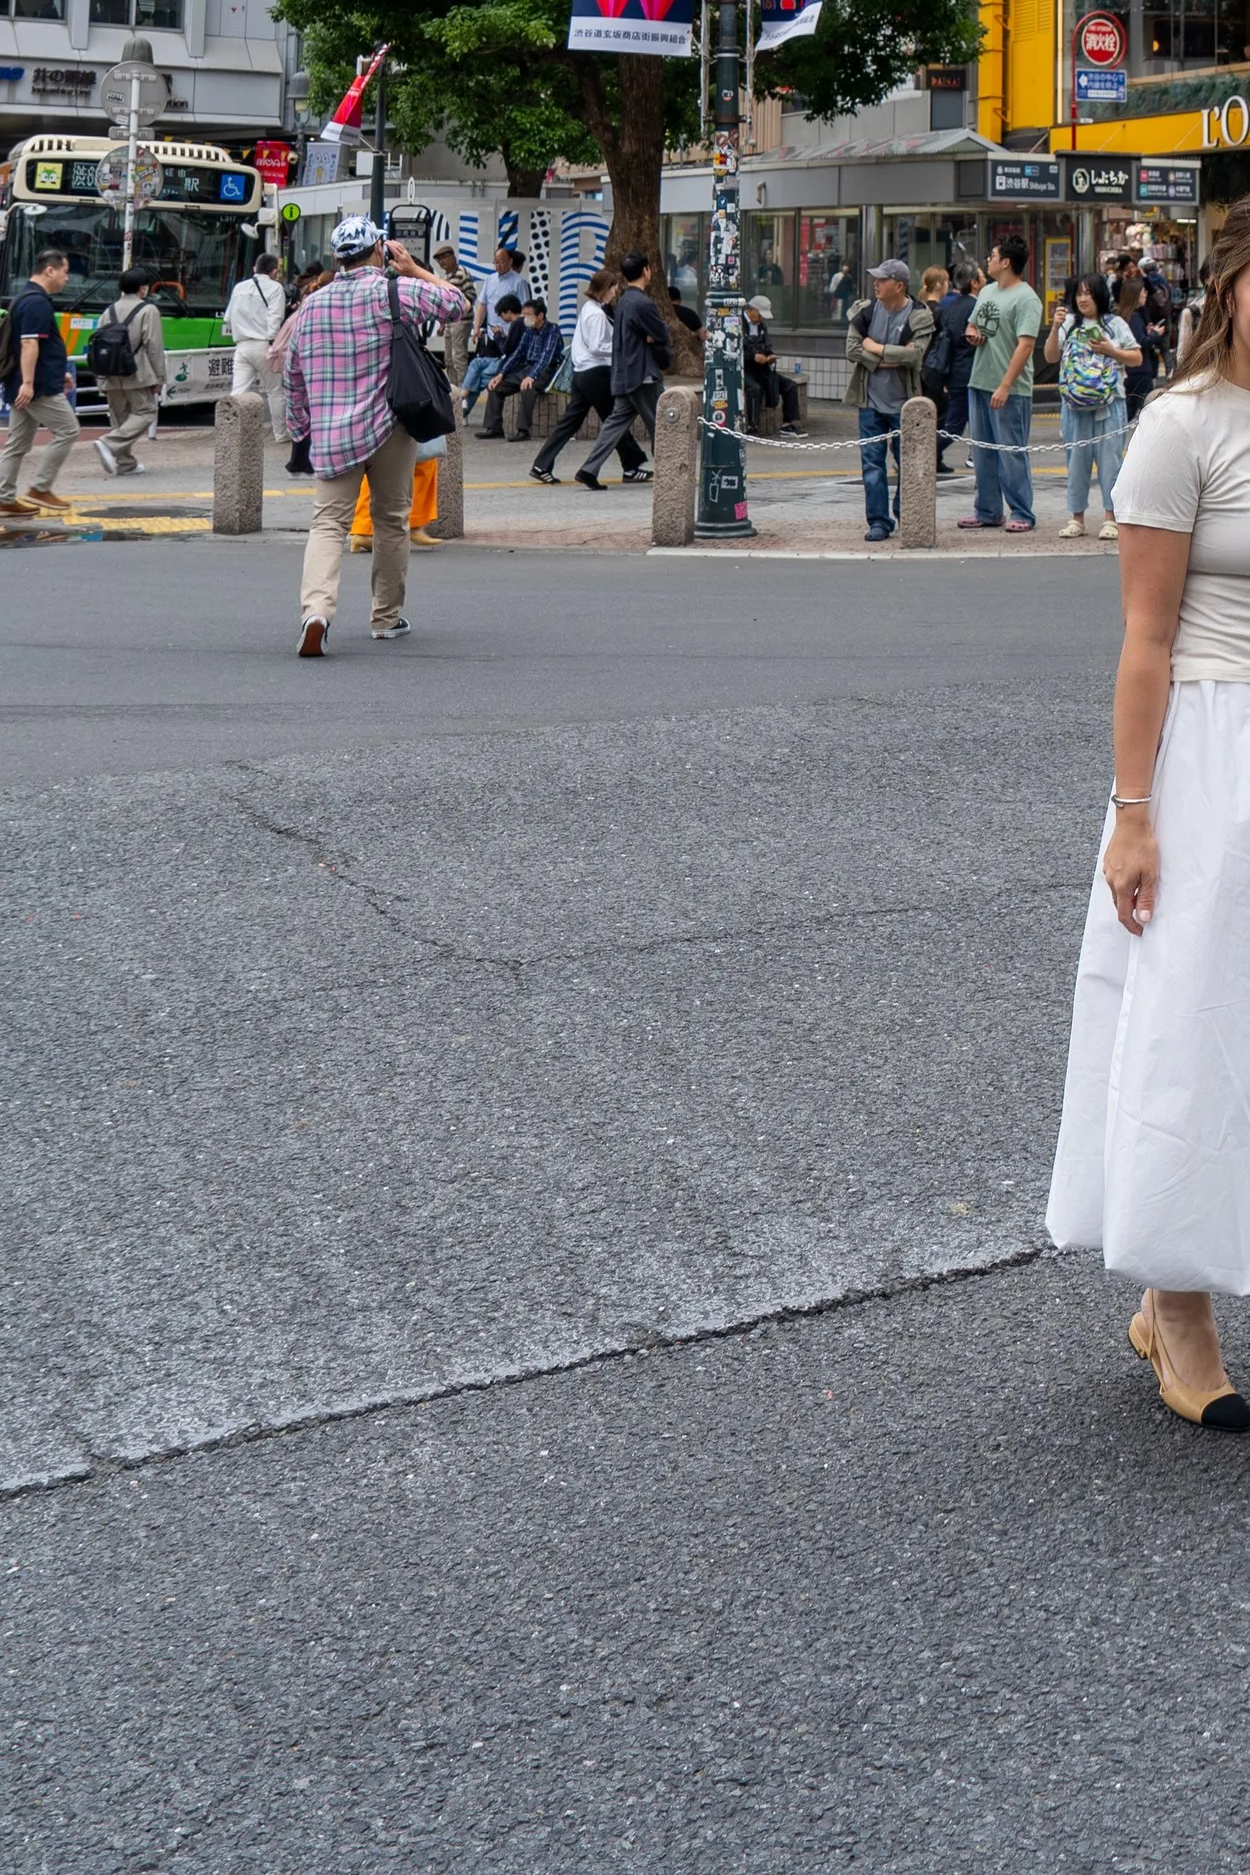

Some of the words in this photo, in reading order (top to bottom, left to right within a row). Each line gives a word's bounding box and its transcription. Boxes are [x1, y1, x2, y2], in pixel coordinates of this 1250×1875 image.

[574, 28, 687, 45] 渋谷道玄坂商店街振興組合
[1085, 32, 1116, 52] 消火栓
[1006, 177, 1029, 190] 渋谷駅
